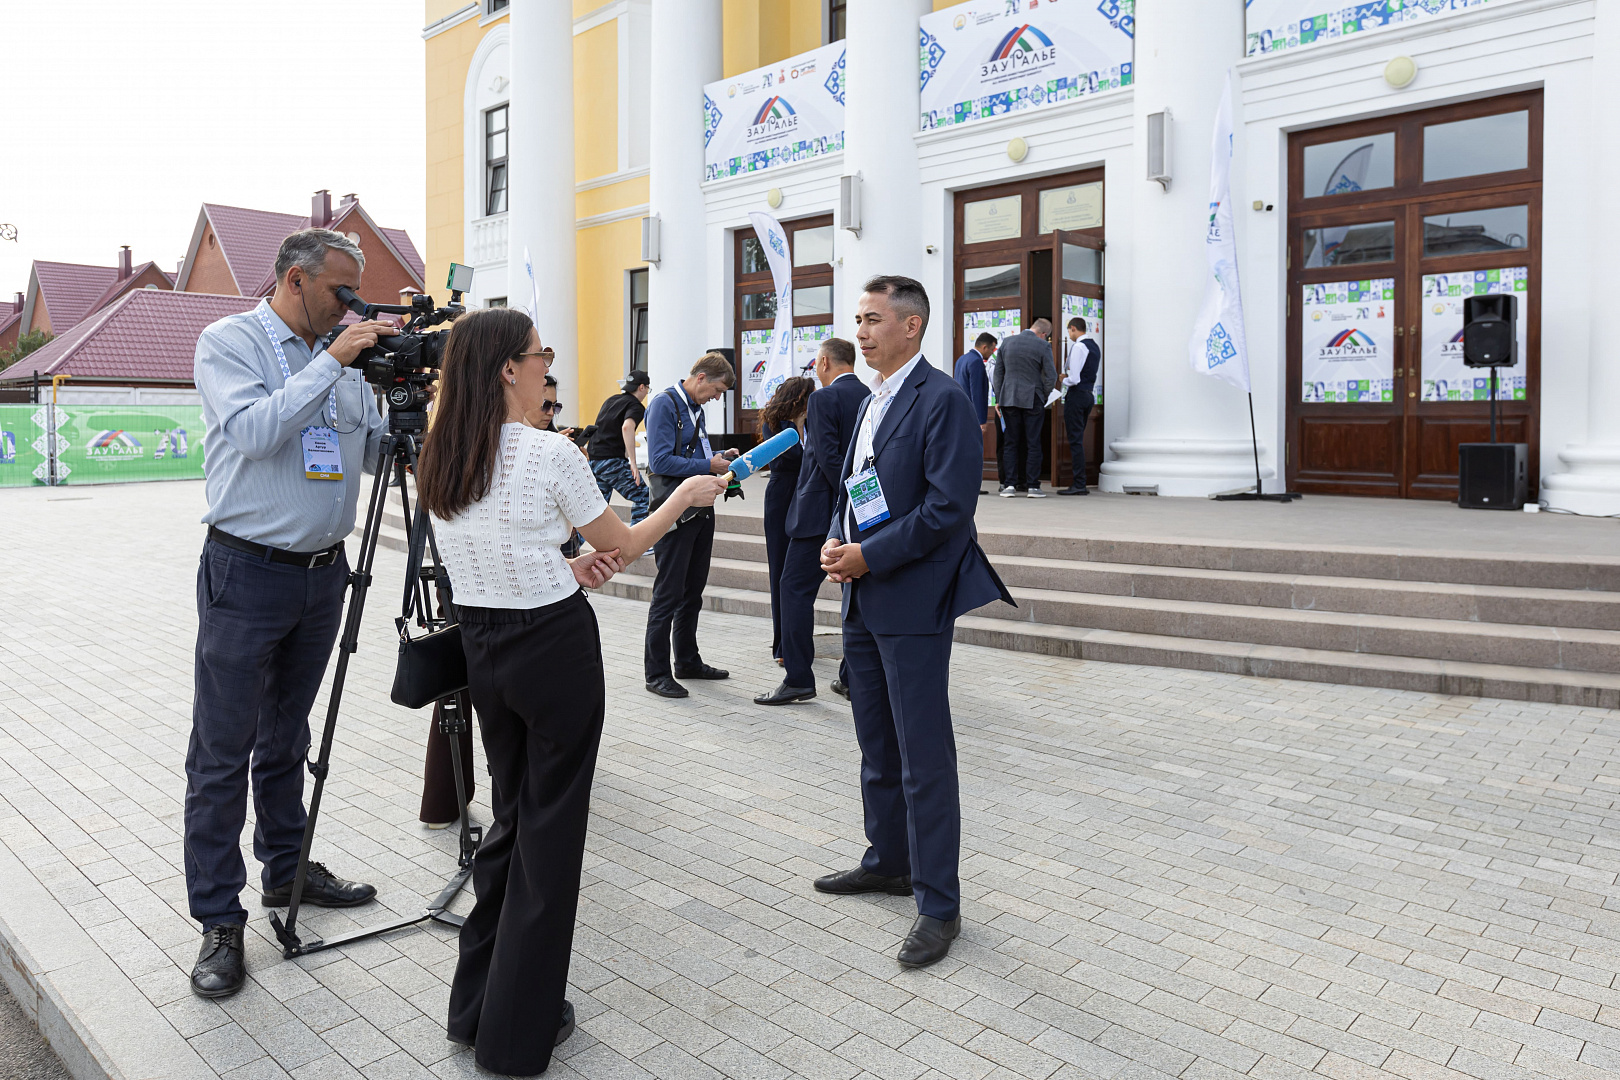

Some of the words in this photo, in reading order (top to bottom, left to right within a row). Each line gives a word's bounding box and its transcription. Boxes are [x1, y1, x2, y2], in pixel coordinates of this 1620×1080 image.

[981, 48, 1056, 77] ЗАУРАЛЬЕ
[747, 115, 798, 138] ЗАУРАЛЬЕ
[1319, 343, 1377, 356] ЗАУРАЛЬЕ
[86, 442, 144, 456] ЗАУРАЛЬЕ
